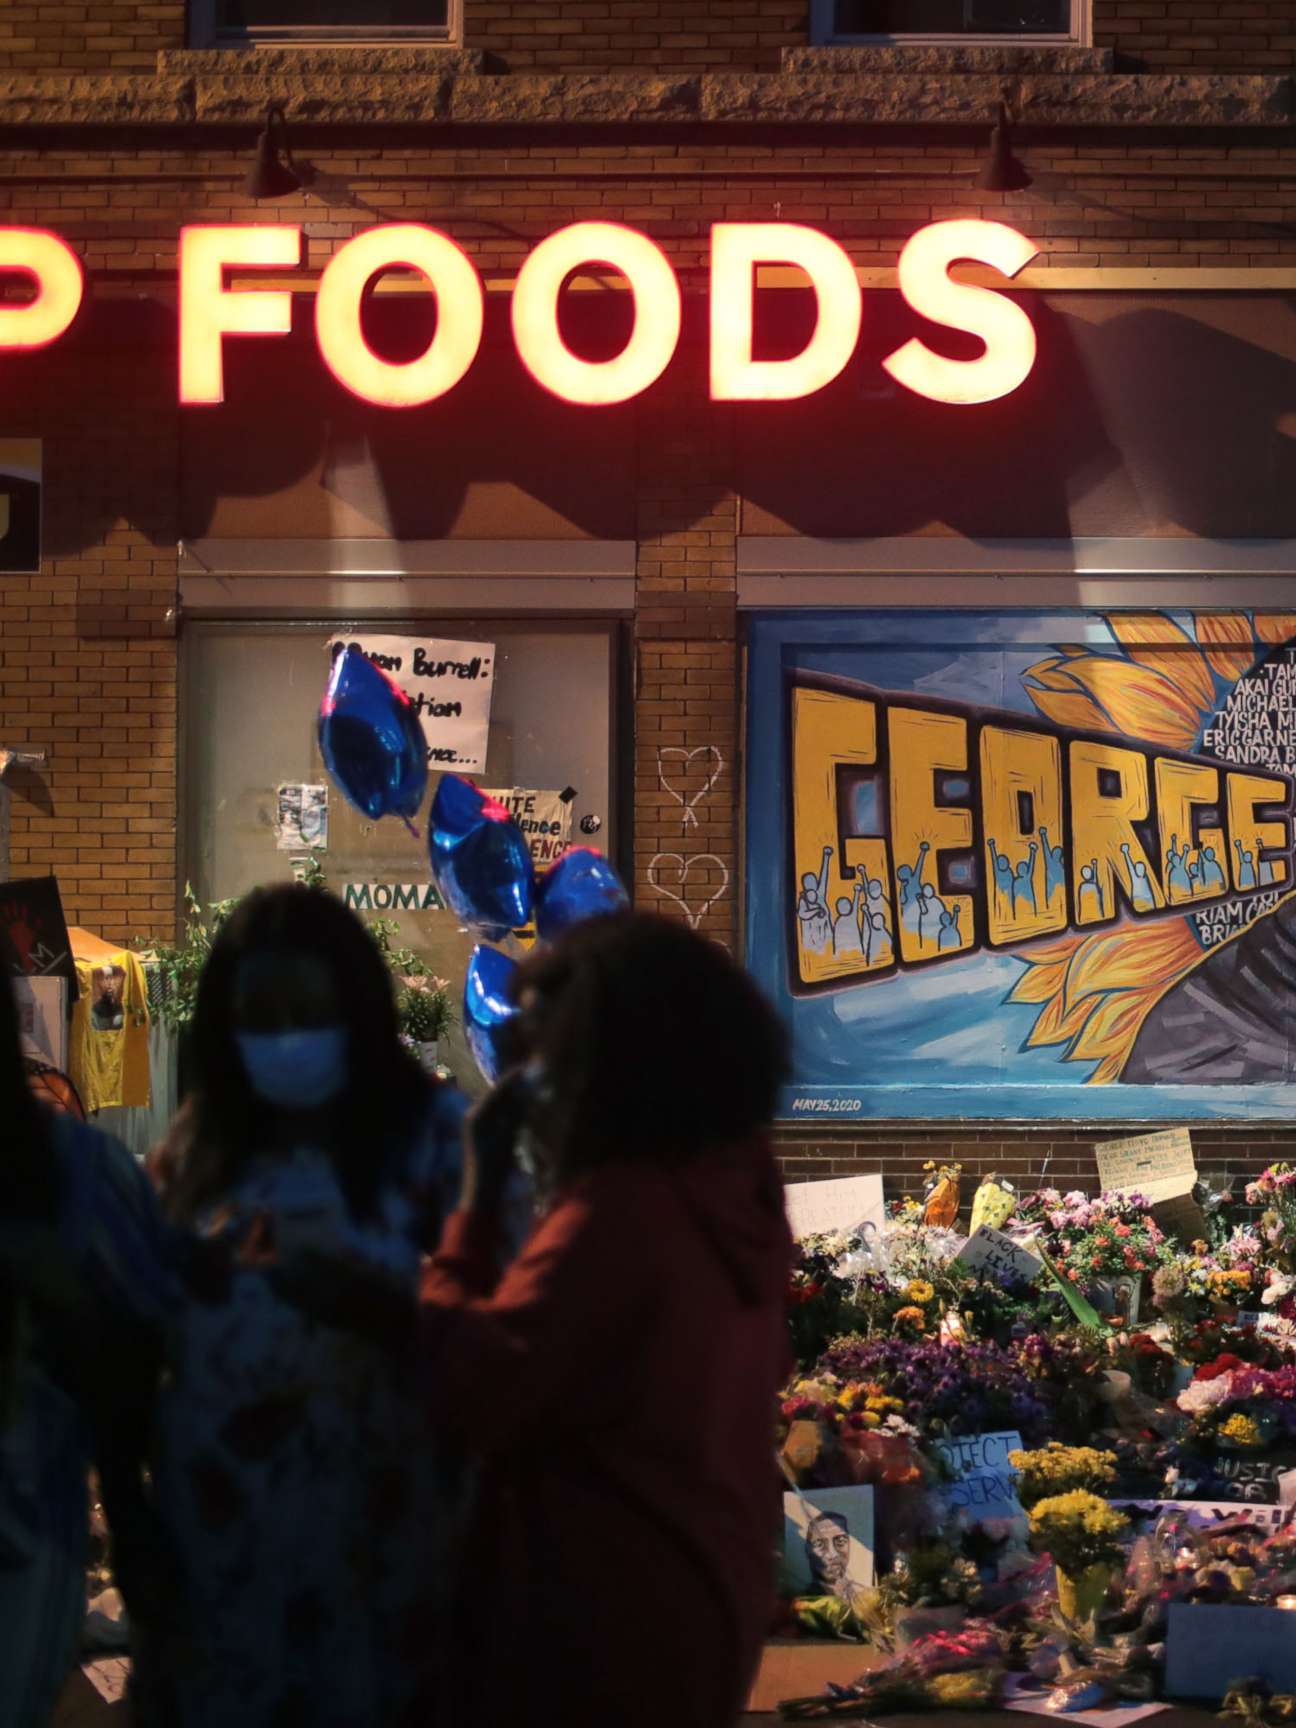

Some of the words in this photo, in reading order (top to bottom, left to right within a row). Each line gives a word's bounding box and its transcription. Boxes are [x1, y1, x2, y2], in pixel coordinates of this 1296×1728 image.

[179, 218, 1039, 406] FOODS
[1234, 679, 1268, 696] AKAI
[1215, 711, 1271, 731] TYISHA
[1204, 730, 1240, 747] ERIC
[1215, 746, 1280, 764] SANDRA
[792, 688, 1287, 984] GEORGE
[345, 884, 445, 910] MOMA
